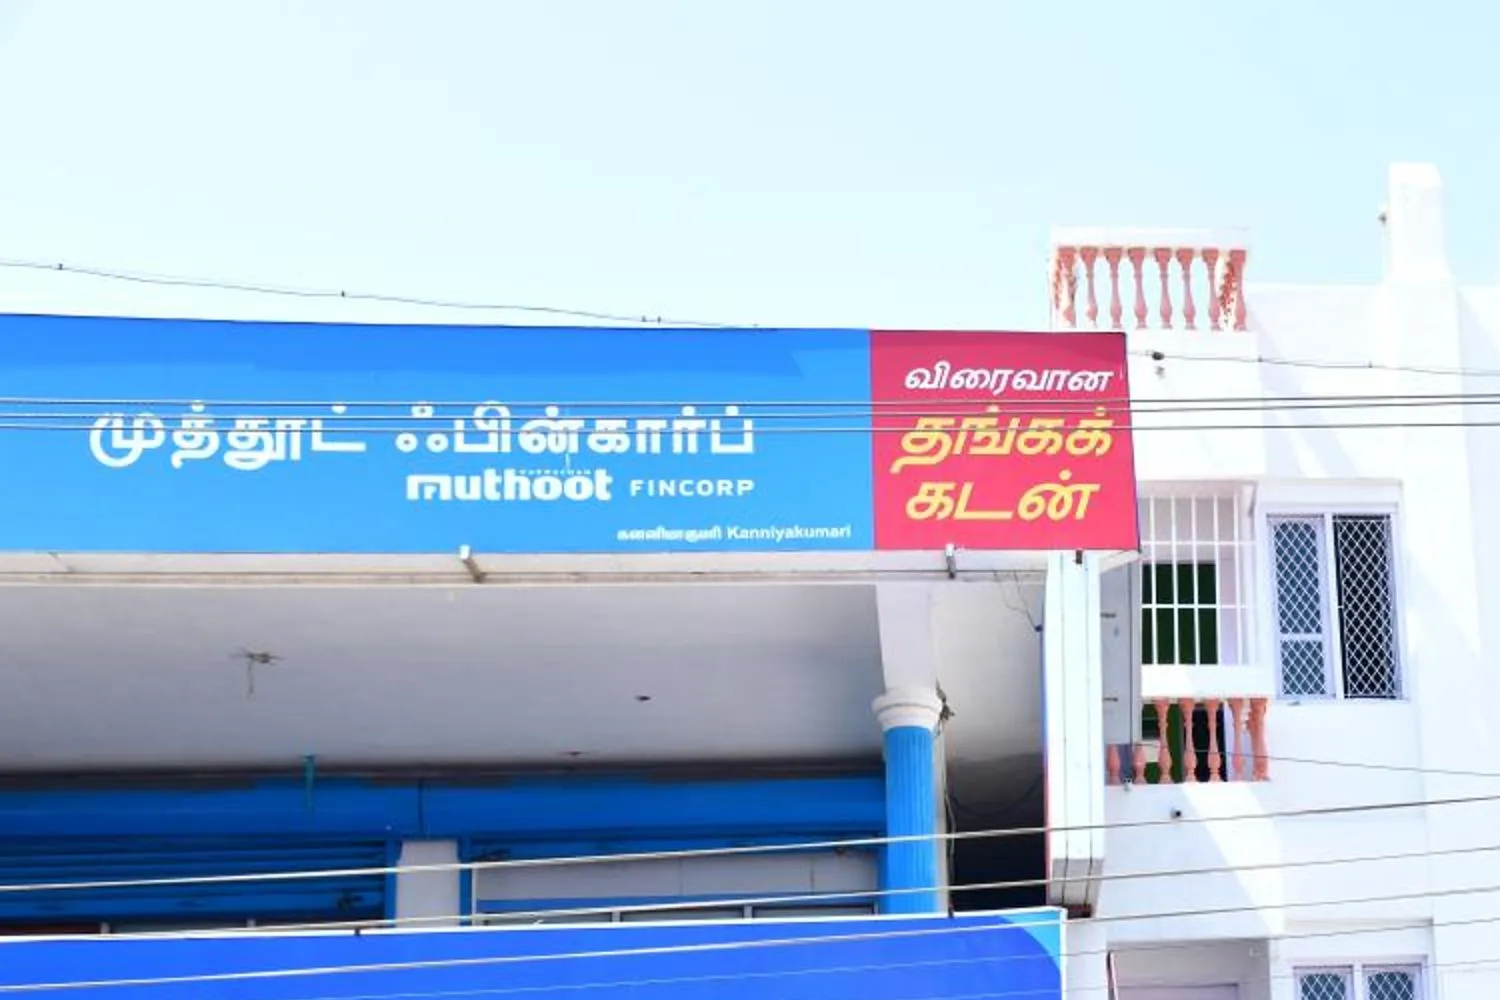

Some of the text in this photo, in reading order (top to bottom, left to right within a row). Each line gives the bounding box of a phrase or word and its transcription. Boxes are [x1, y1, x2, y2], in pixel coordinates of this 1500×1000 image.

[904, 360, 1114, 396] விரைவான
[89, 401, 755, 470] முத்தூட் ஃபின்கார்ப்
[890, 405, 1113, 474] தங்கக்
[406, 468, 755, 501] muthoot FINCORP
[905, 469, 1100, 521] கடன்
[727, 525, 852, 543] Kanniyakumari
